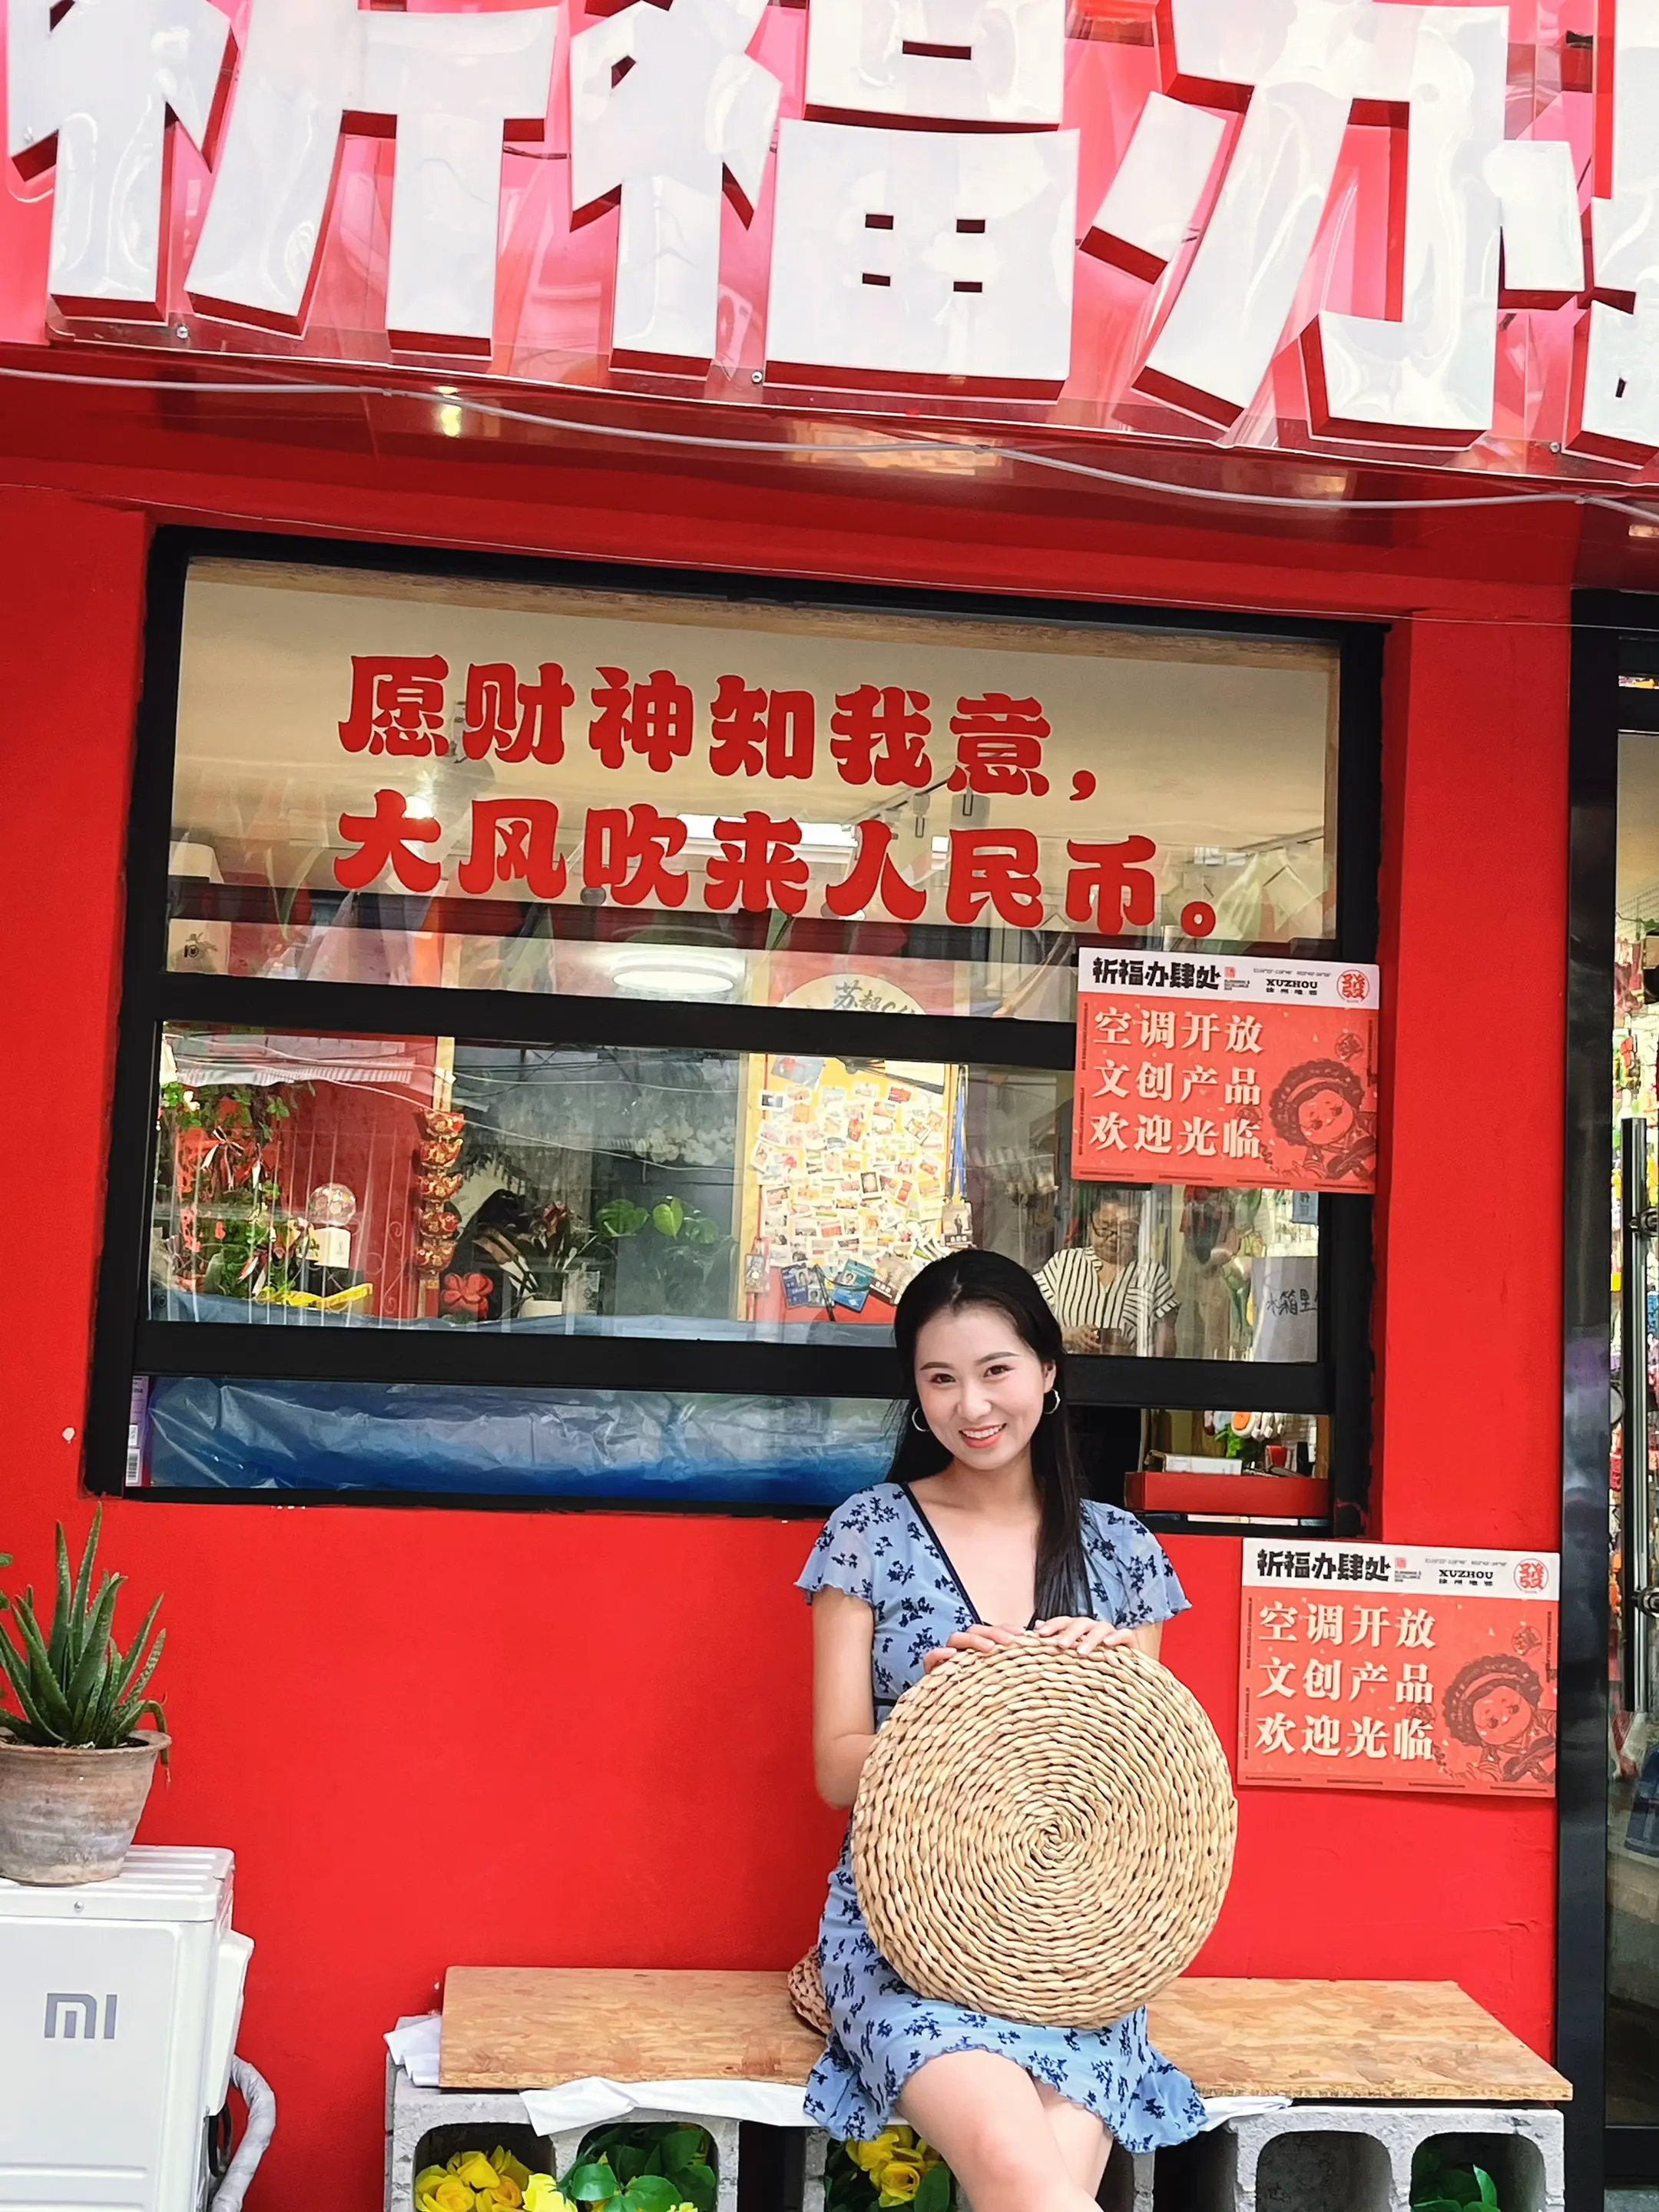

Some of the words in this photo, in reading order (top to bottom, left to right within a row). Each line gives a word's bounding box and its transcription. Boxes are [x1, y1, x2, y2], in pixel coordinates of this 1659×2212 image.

[6, 0, 1659, 453] 祈福办
[338, 655, 1097, 800] 愿财神知我意，
[333, 790, 1216, 938] 大风吹来人民币。
[1092, 956, 1222, 991] 祈福办肆处
[1266, 979, 1319, 989] XUZHOU
[1093, 1006, 1264, 1055] 空调开放
[1091, 1058, 1262, 1106] 文创产品
[1088, 1111, 1262, 1159] 欢迎光临
[1257, 1548, 1392, 1583] 祈福办肆处
[1439, 1569, 1494, 1580] XUZHOU
[1258, 1600, 1437, 1649] 空调开放
[1257, 1656, 1435, 1704] 文创产品
[1254, 1712, 1435, 1761] 欢迎光临
